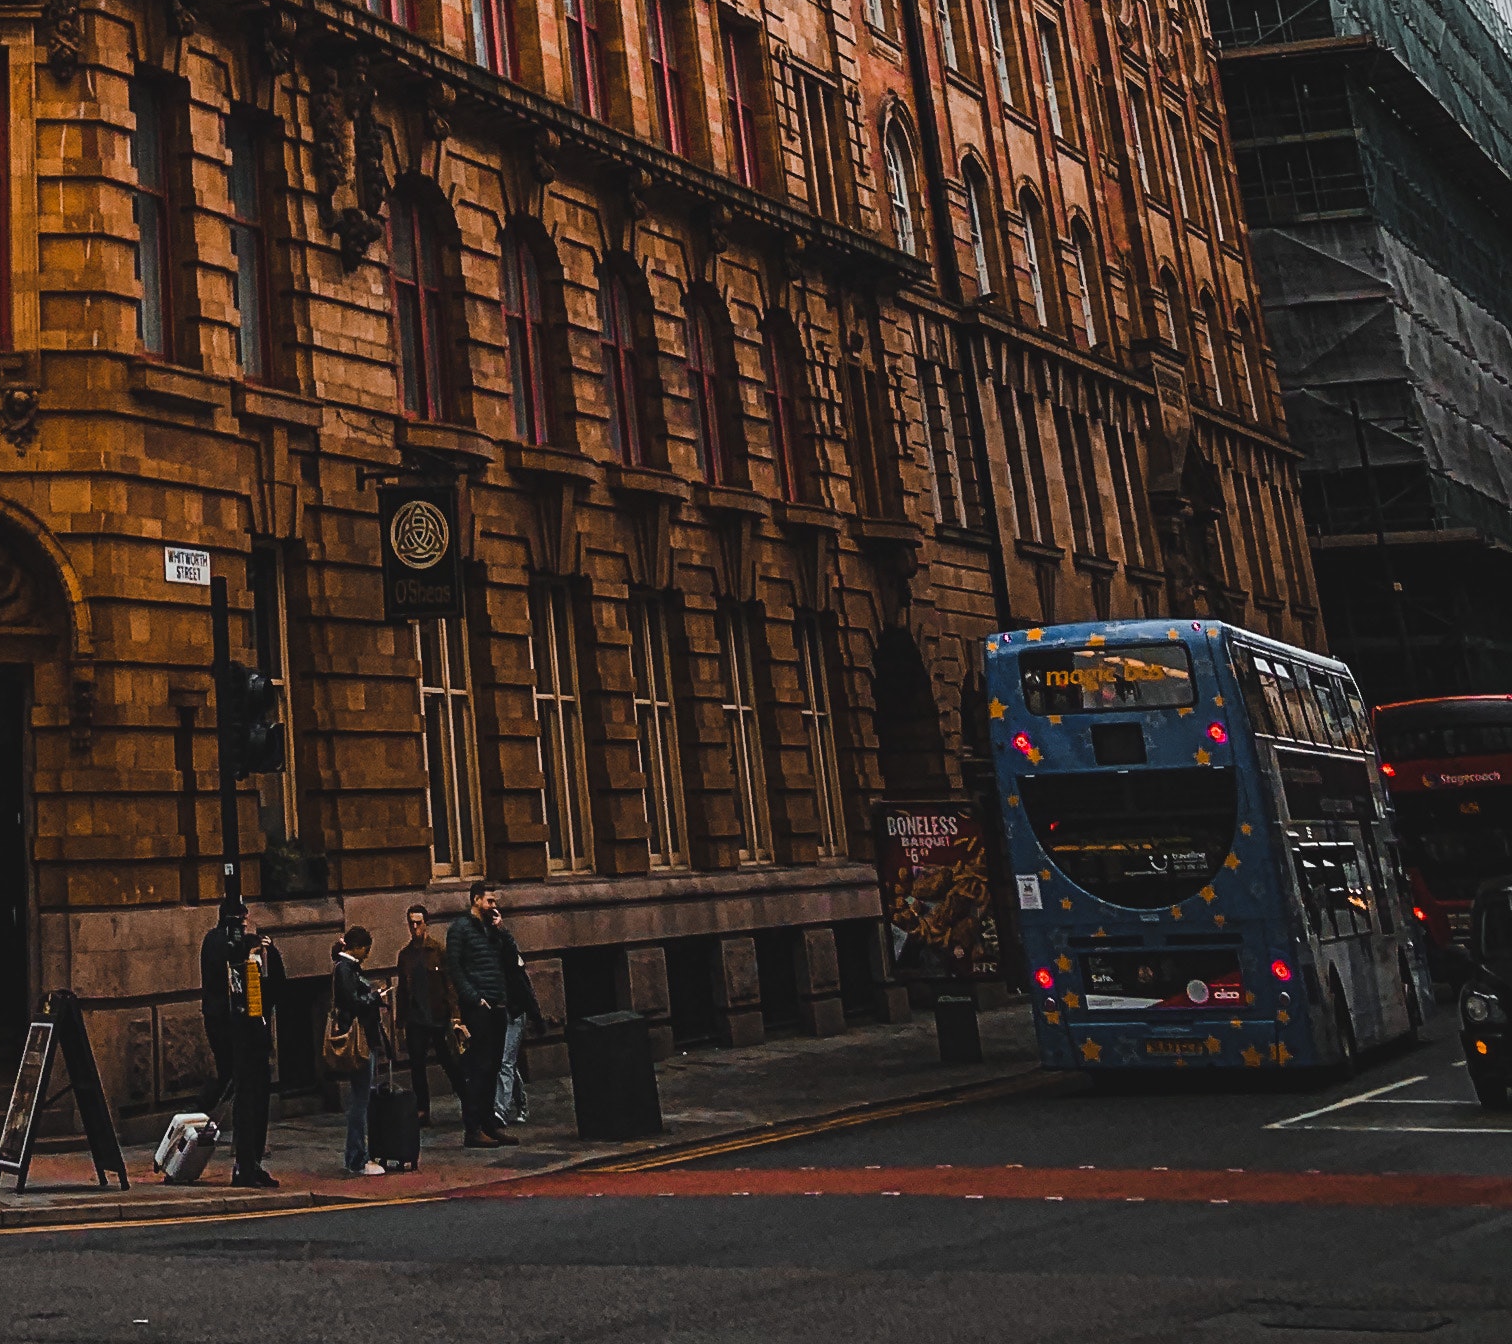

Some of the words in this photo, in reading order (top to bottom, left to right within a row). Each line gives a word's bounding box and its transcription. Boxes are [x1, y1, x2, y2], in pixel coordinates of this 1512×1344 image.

[168, 550, 208, 567] WHITWORTH
[176, 565, 201, 581] STREET
[1046, 663, 1117, 692] magic
[1123, 662, 1166, 683] bus
[1440, 771, 1501, 786] Stagecoach
[887, 816, 959, 836] BONELESS
